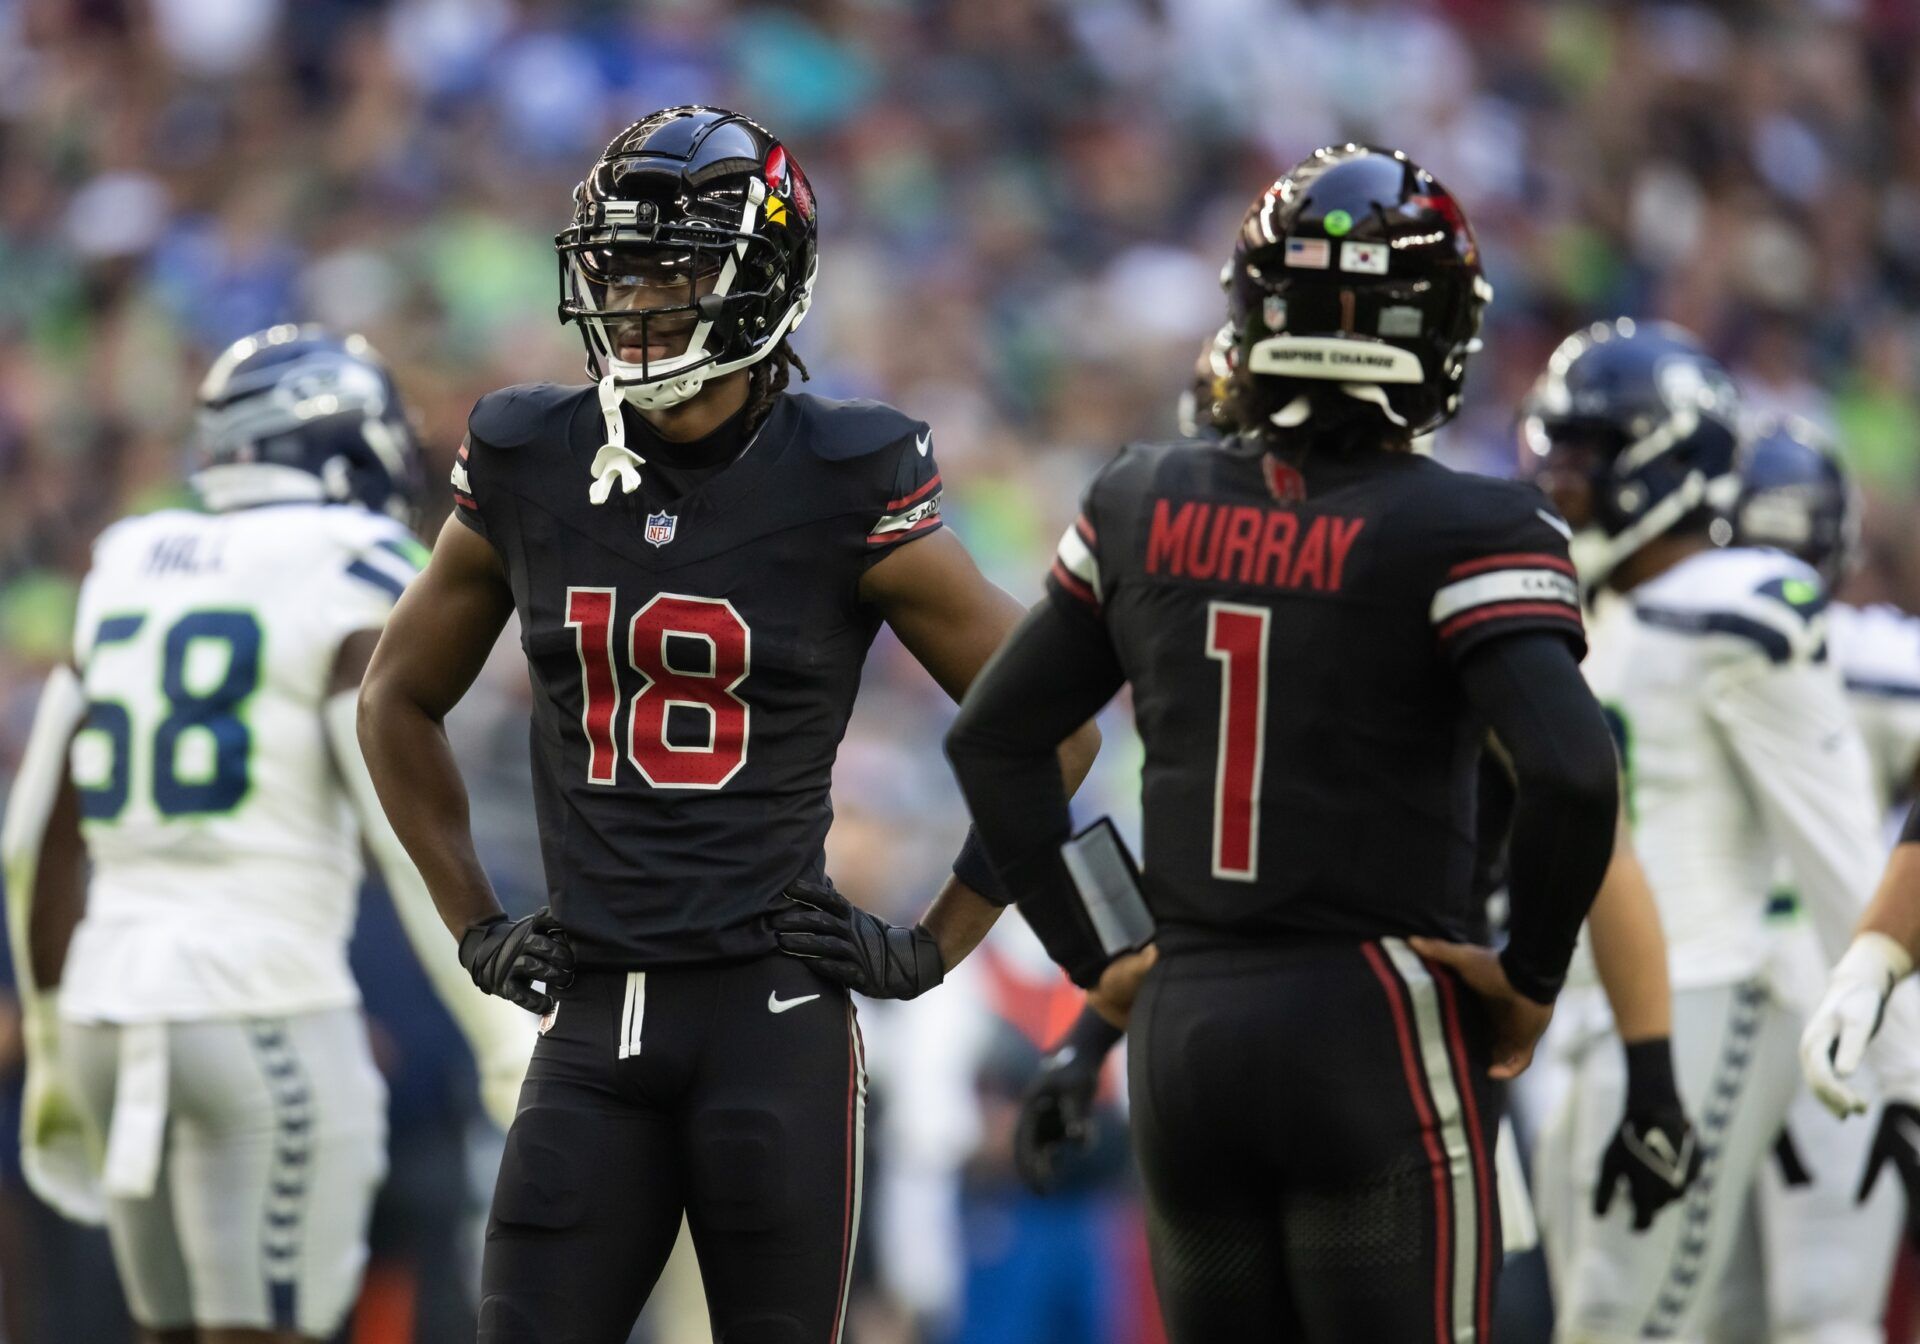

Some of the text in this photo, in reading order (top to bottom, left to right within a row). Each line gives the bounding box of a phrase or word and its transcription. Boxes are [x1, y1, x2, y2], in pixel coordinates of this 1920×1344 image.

[649, 526, 669, 540] NFL
[1145, 498, 1365, 592] MURRAY
[70, 609, 266, 824] 58
[564, 586, 750, 790] 18
[1205, 600, 1272, 883] 1
